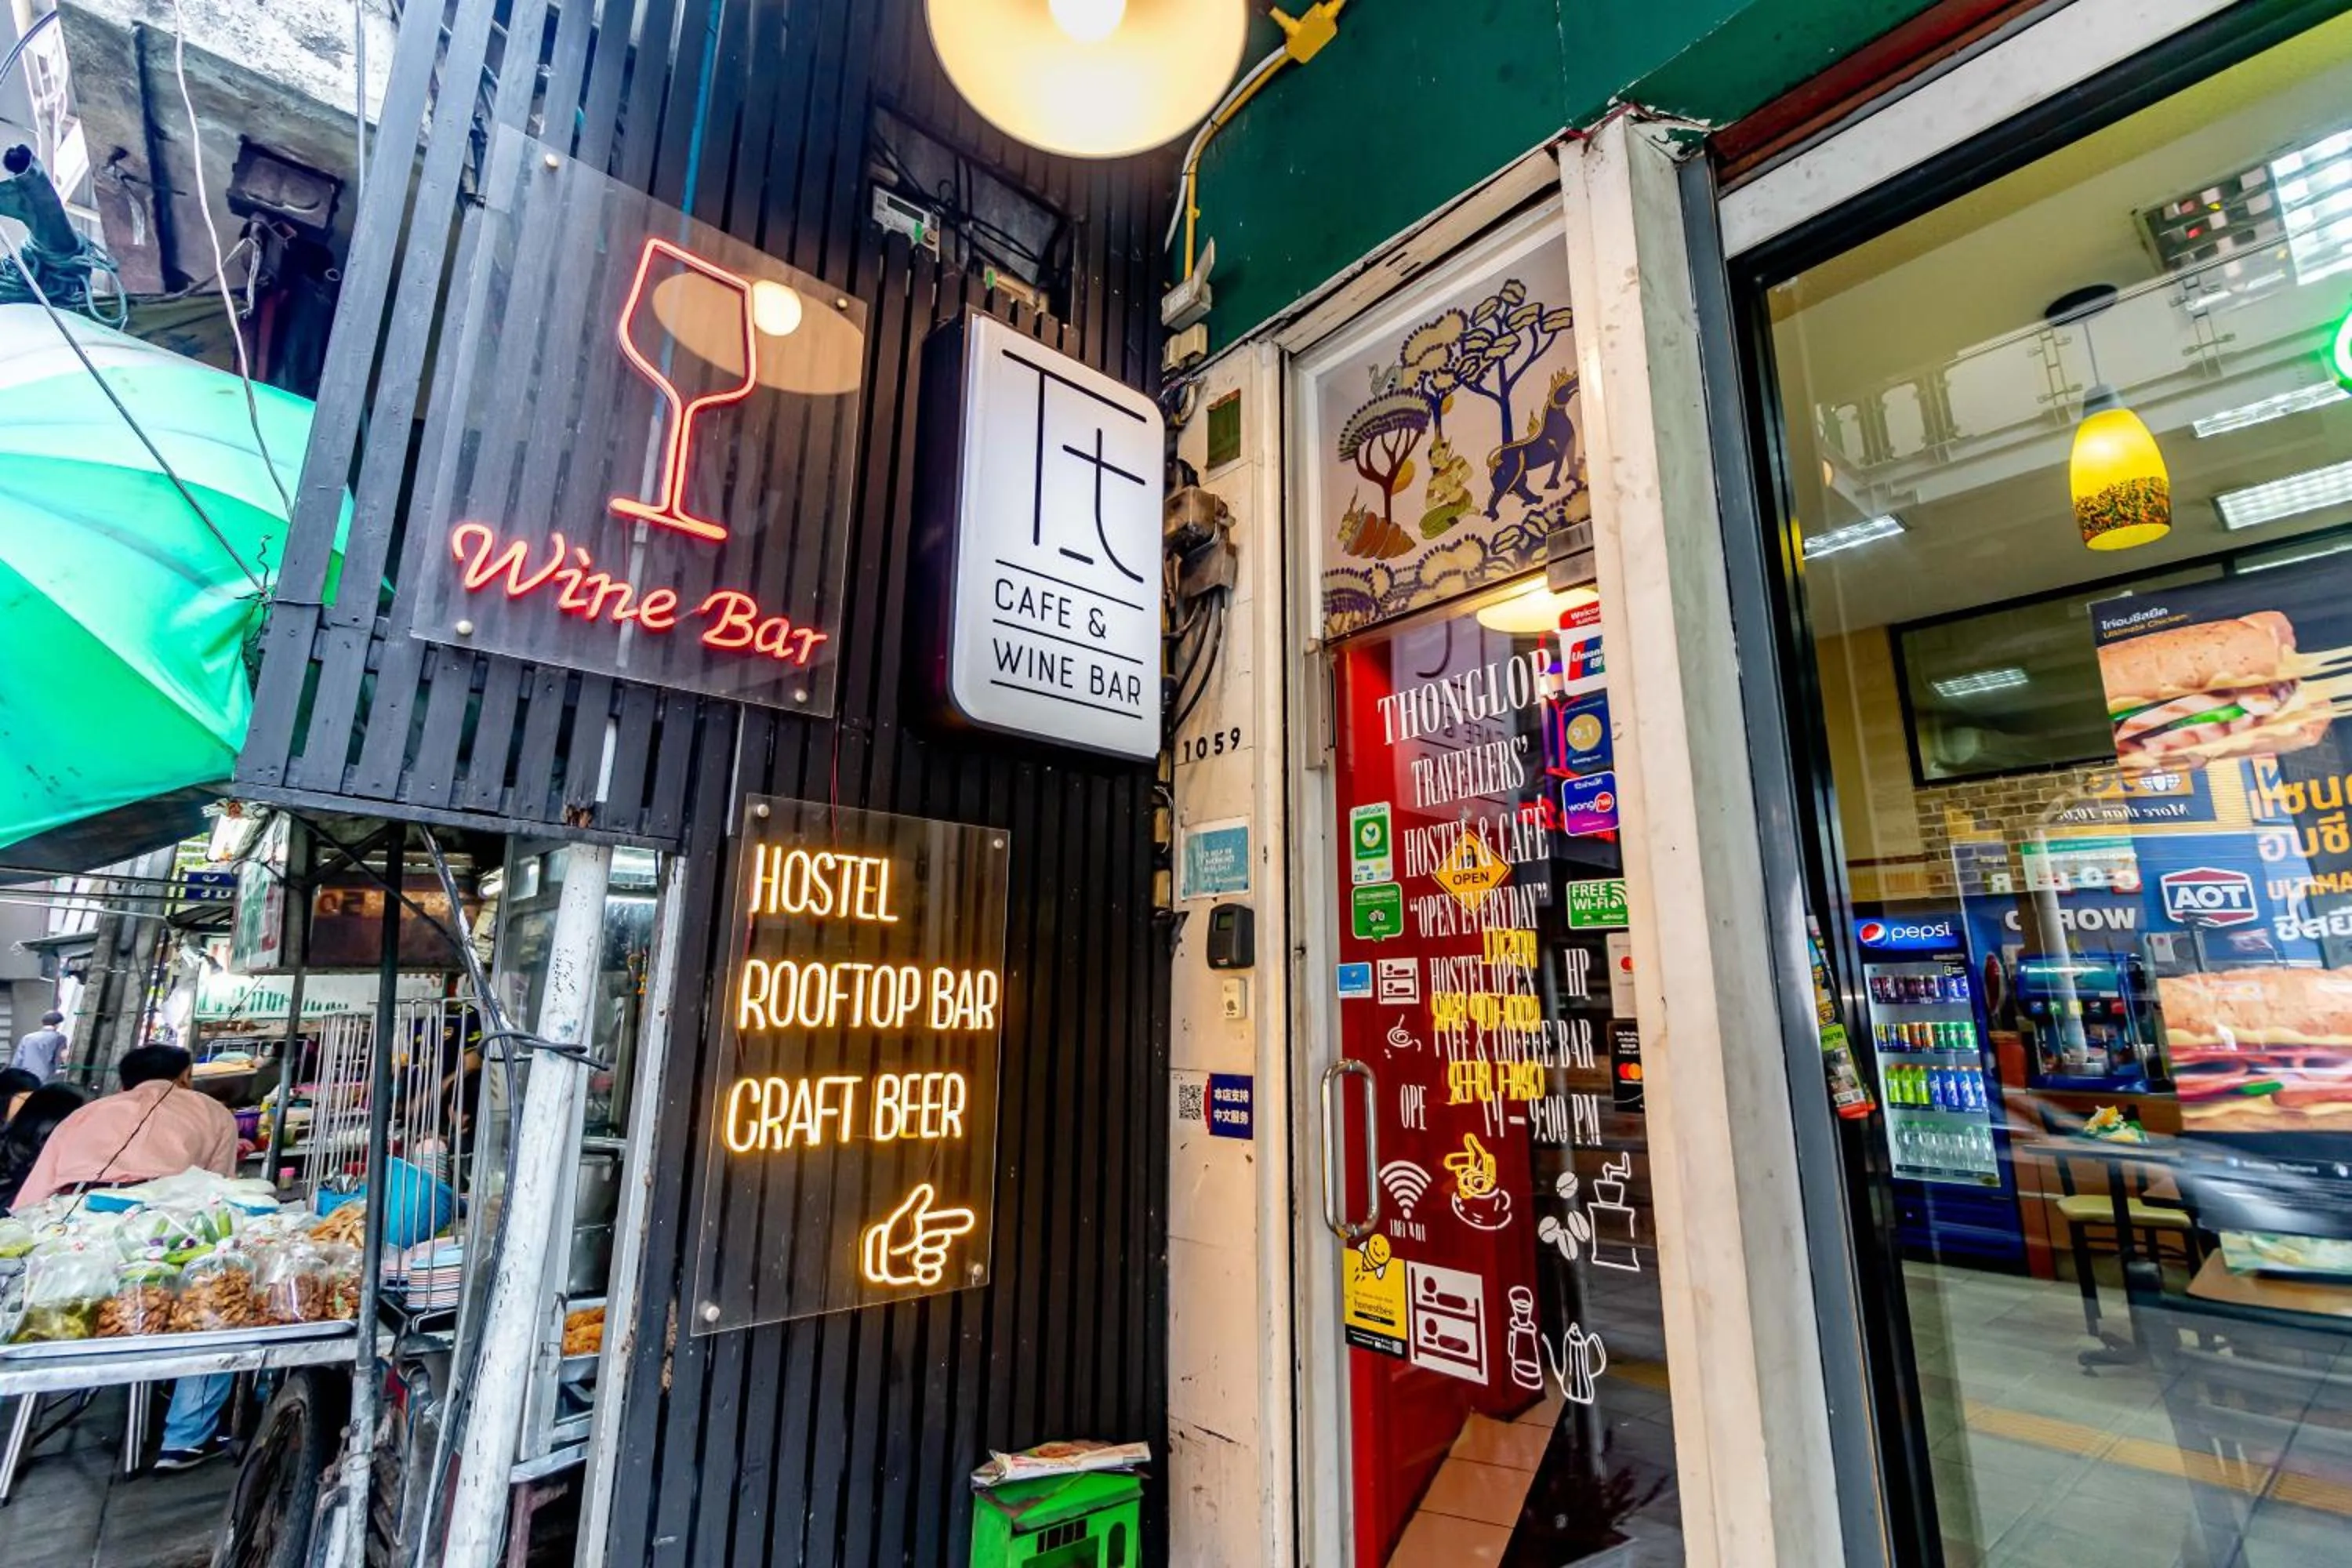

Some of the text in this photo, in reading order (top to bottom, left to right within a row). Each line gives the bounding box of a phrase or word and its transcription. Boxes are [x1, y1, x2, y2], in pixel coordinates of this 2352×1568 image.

[452, 523, 829, 665] Wine Bar
[994, 577, 1107, 640] CAFE &
[993, 637, 1142, 706] WINE BAR
[1377, 648, 1558, 746] THONGLOR
[1183, 727, 1242, 764] 1059
[1403, 818, 1473, 877] HOSTEL
[1479, 816, 1494, 867] &
[750, 843, 899, 923] HOSTEL
[1452, 871, 1490, 886] OPEN
[1572, 884, 1608, 898] FREE
[1573, 897, 1609, 910] WI-FI
[1891, 921, 1951, 942] pepsi
[739, 959, 998, 1031] ROOFTOP BAR
[1557, 1019, 1595, 1069] BAR
[726, 1072, 967, 1152] CRAFT BEER
[1572, 1094, 1602, 1145] PM
